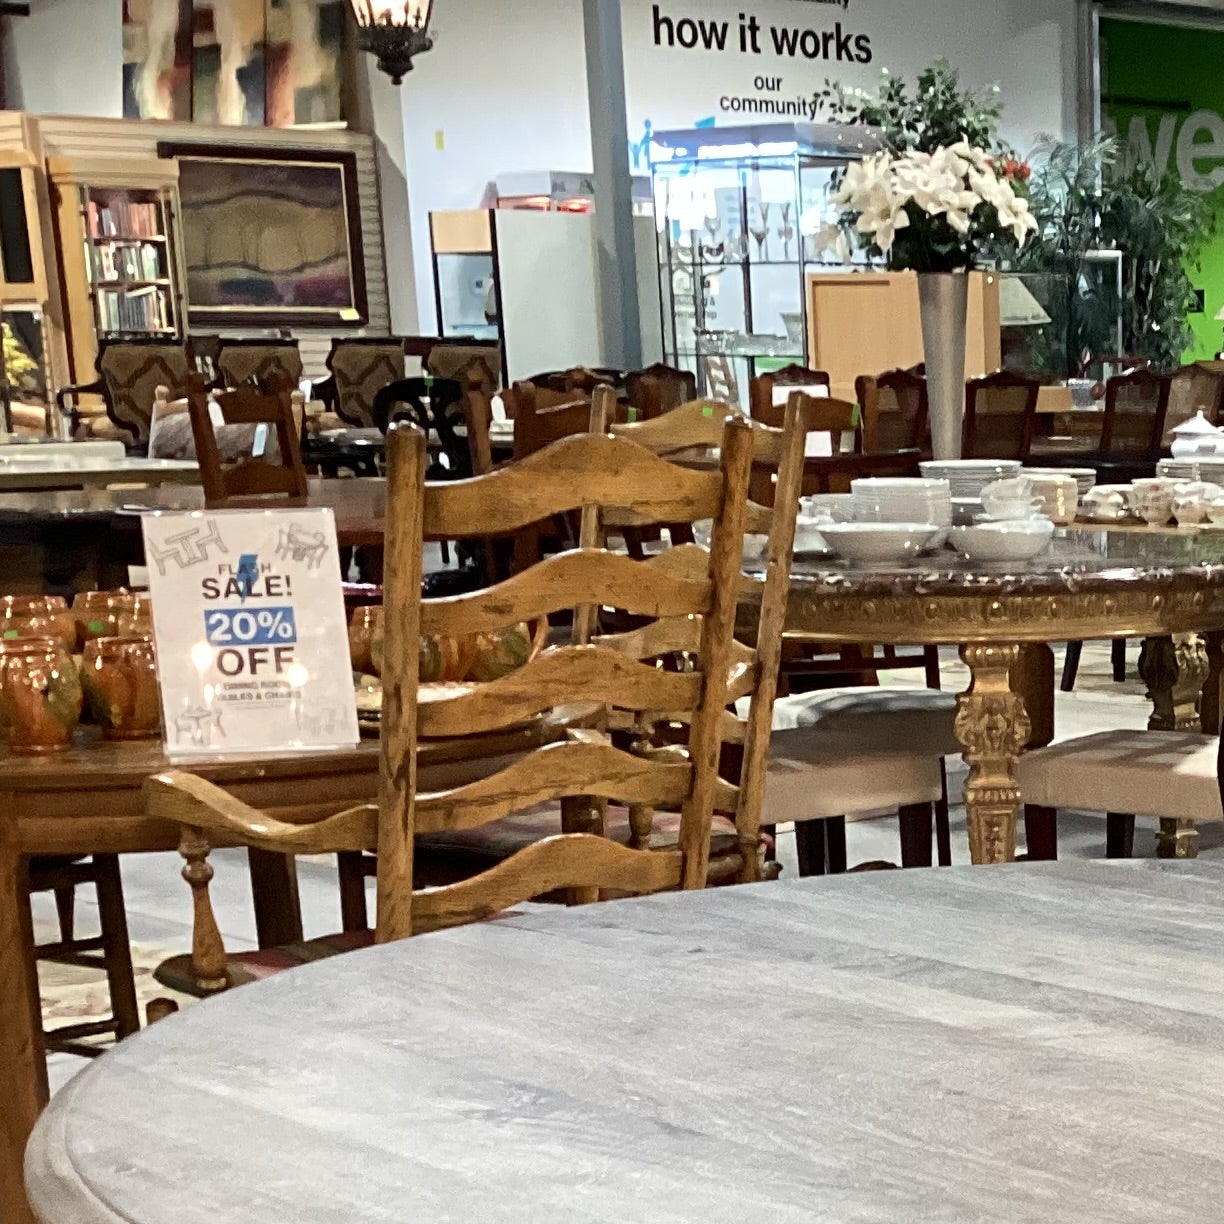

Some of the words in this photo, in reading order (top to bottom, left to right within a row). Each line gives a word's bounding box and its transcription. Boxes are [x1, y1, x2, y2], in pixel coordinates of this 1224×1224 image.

[652, 4, 728, 50] how
[738, 13, 761, 54] it
[770, 22, 872, 64] works
[753, 75, 783, 91] our
[720, 95, 817, 120] community
[218, 562, 272, 576] FLAH
[201, 575, 293, 600] SALE!
[208, 610, 294, 641] 20%
[216, 646, 296, 677] OFF
